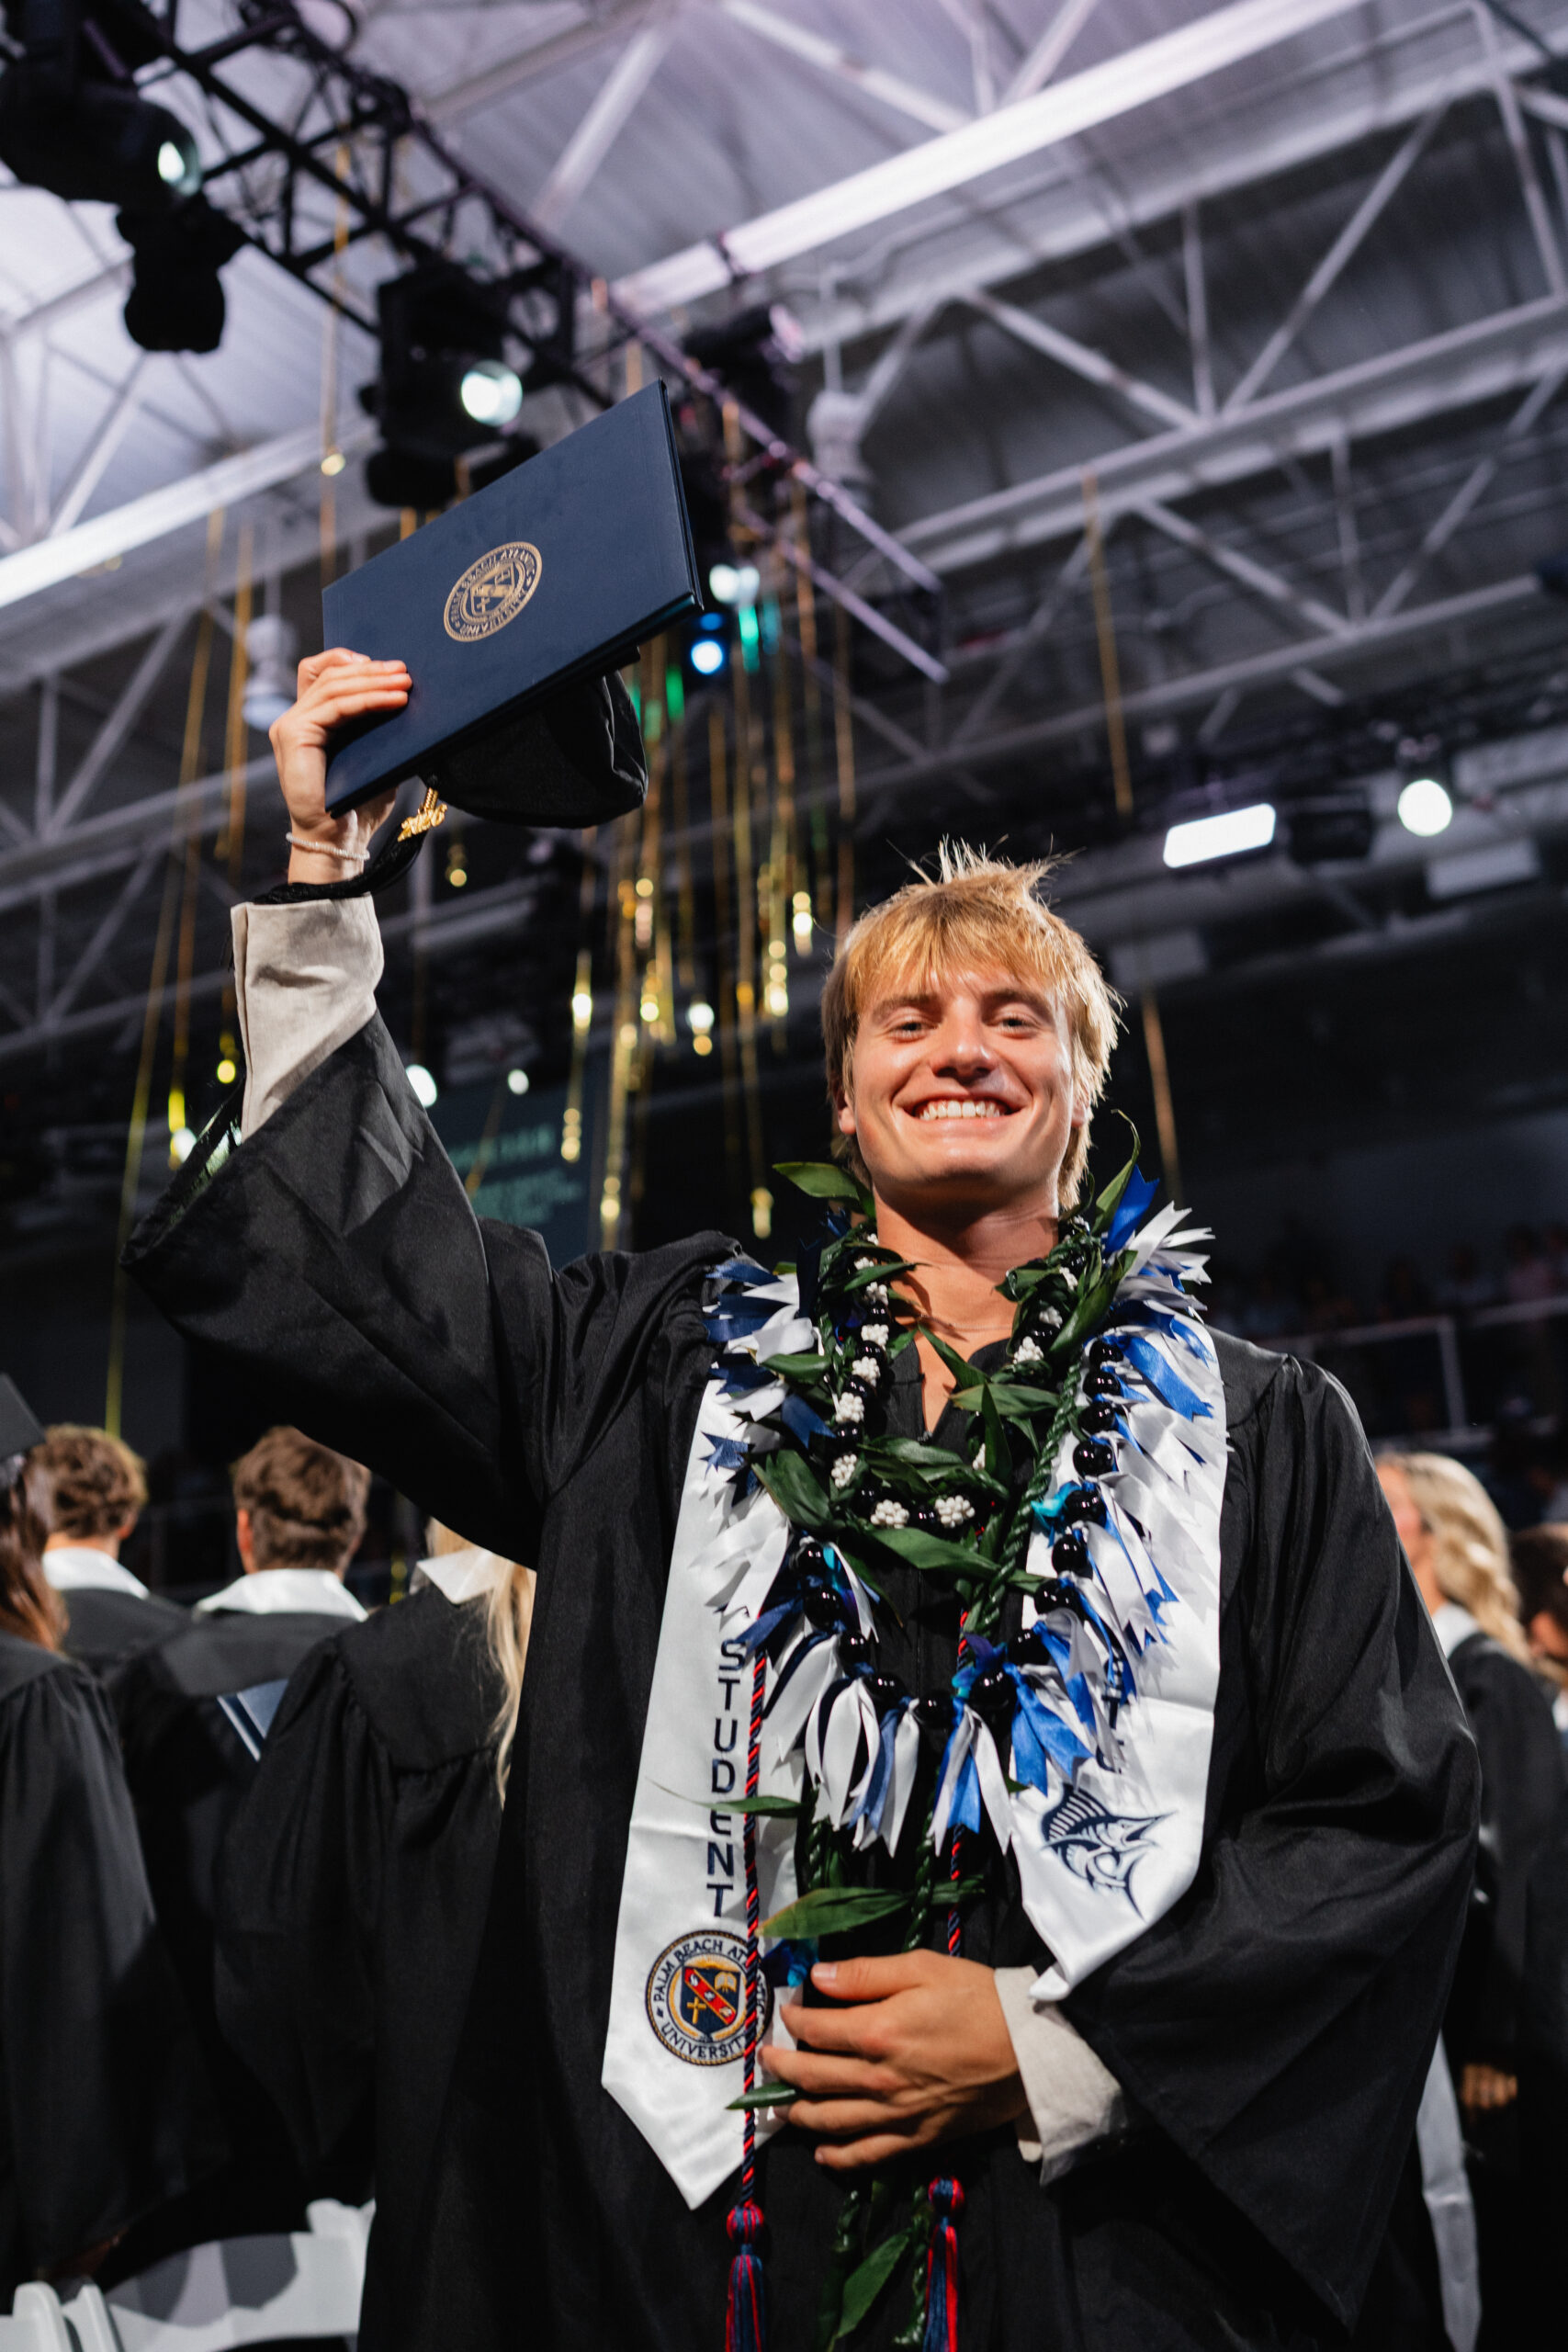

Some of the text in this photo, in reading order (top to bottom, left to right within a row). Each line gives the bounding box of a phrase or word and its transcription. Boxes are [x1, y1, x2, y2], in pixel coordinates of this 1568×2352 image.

[705, 1639, 745, 1917] STUDENT
[653, 1961, 675, 2002] PALM
[673, 1939, 724, 1963] BEACH
[660, 2022, 745, 2059] UNIVERSIT
